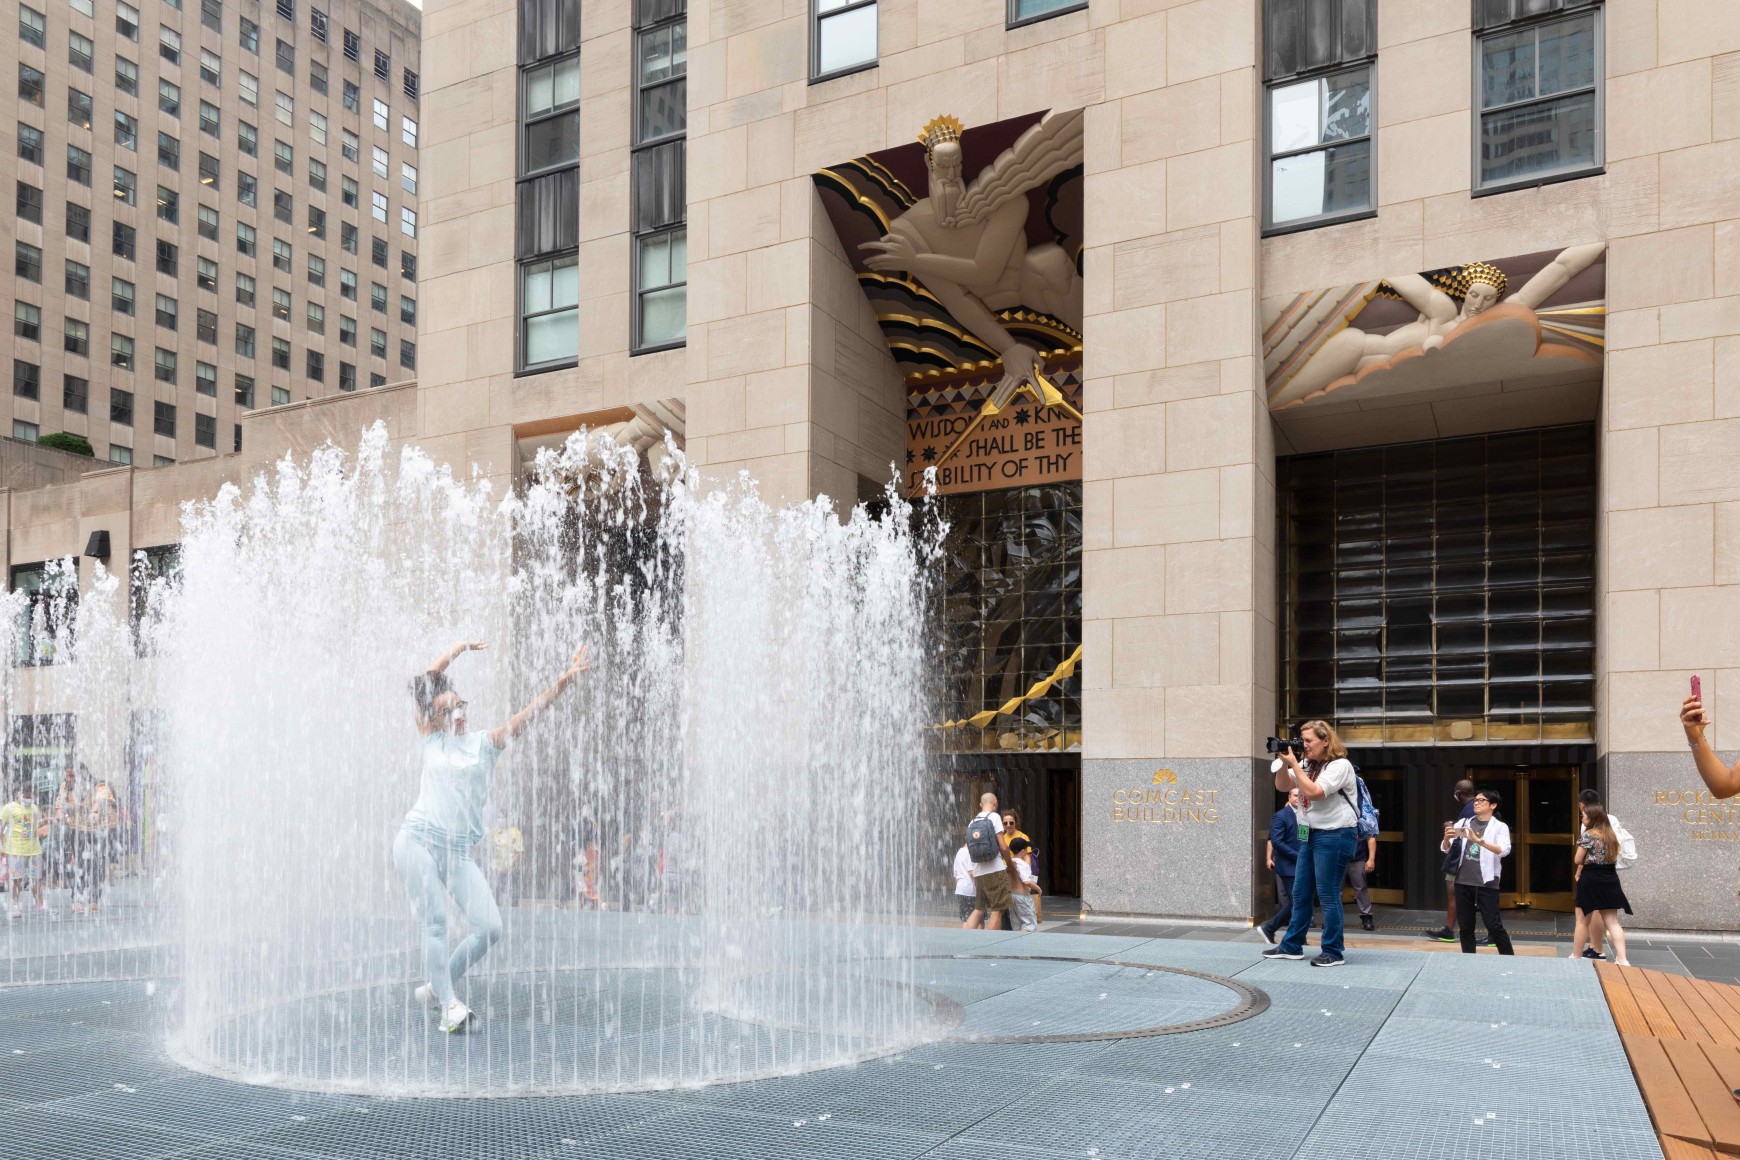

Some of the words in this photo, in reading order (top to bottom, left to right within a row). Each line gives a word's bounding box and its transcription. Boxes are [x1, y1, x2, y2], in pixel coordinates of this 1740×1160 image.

[989, 418, 1010, 431] AND
[1034, 406, 1071, 424] KN
[966, 435, 1019, 458] SHALL
[1024, 431, 1045, 451] BE
[1052, 426, 1081, 448] THE
[1001, 458, 1029, 478] OF
[1034, 452, 1073, 474] THY
[1112, 788, 1218, 805] COMCAST
[1112, 807, 1219, 823] BUILDING
[1683, 809, 1740, 825] CENT
